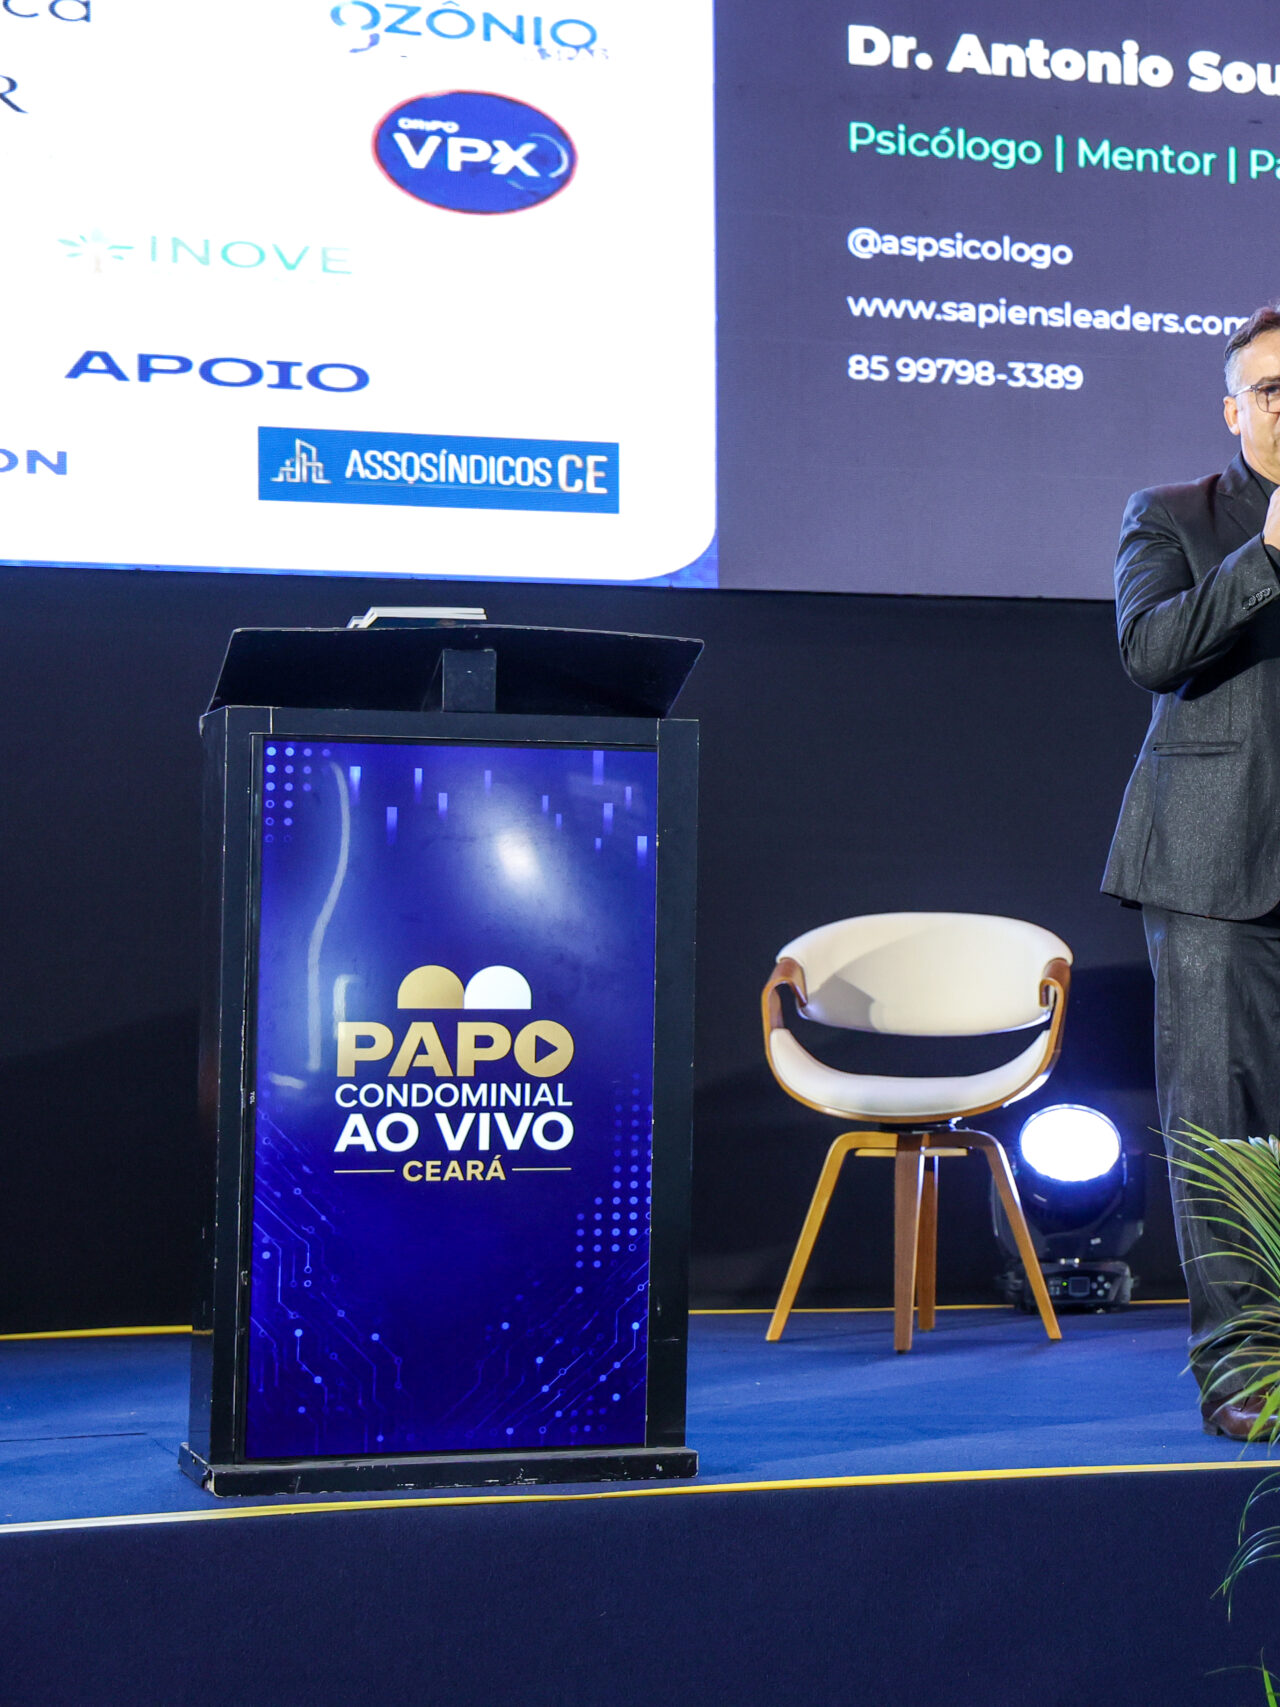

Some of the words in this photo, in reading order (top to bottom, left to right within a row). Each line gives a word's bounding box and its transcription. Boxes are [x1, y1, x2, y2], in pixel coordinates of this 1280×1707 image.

[847, 24, 933, 70] Dr.
[945, 33, 1174, 88] Antonio
[393, 132, 541, 178] VPX
[849, 121, 1043, 170] Psicólogo
[1077, 137, 1218, 177] Mentor
[151, 235, 353, 274] INOVE
[847, 227, 1074, 270] @aspsicologo
[64, 350, 371, 393] APOIO
[847, 354, 890, 382] 85
[895, 356, 1084, 391] 99798-3389
[558, 454, 609, 494] CE
[336, 1019, 575, 1078] PAPO
[334, 1083, 573, 1108] CONDOMINIAL
[333, 1112, 420, 1152] AO
[434, 1111, 575, 1151] VIVO
[402, 1155, 506, 1182] CEARÁ
